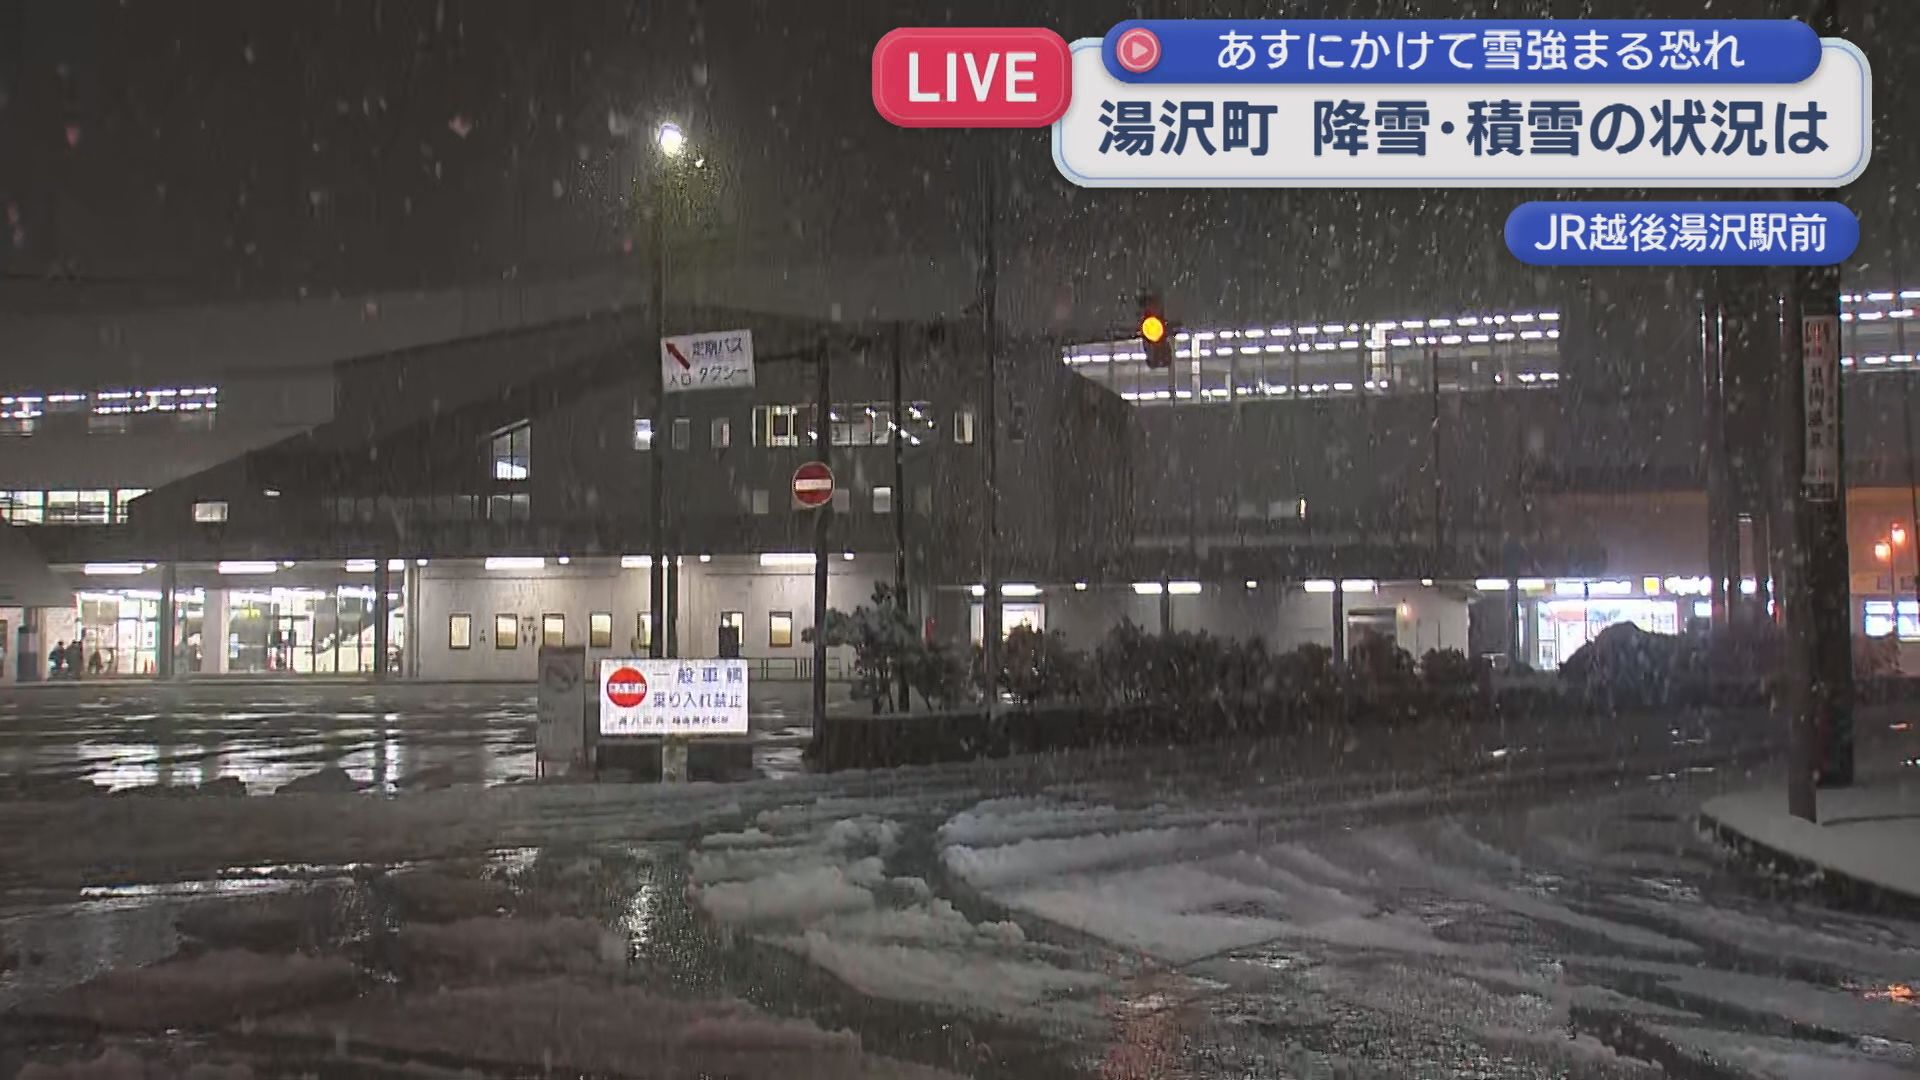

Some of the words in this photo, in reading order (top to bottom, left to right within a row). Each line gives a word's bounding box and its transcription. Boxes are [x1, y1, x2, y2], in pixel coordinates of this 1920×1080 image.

[699, 366, 748, 383] タクシー
[653, 691, 743, 709] 乗り入れ禁止
